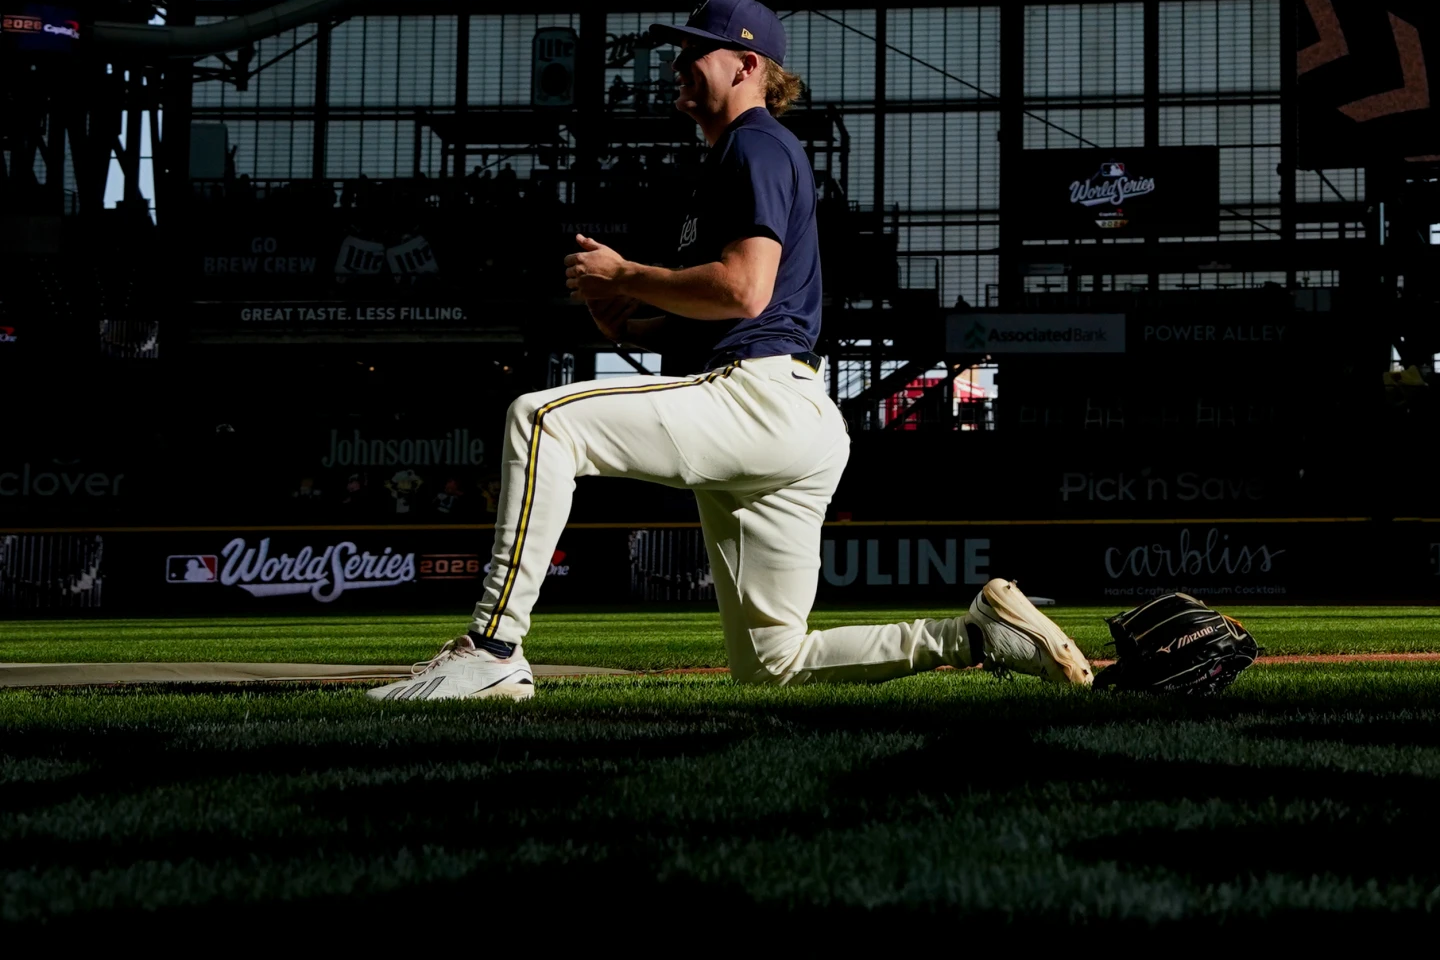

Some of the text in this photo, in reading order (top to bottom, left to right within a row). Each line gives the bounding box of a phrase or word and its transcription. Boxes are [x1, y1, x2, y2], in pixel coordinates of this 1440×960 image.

[560, 222, 629, 234] TASTES LIKE
[250, 236, 278, 254] GO
[203, 255, 317, 275] BREW CREW
[240, 306, 468, 322] GREAT TASTE. LESS FILLING.
[1143, 324, 1288, 342] POWER ALLEY
[321, 427, 486, 469] Johnsonville
[0, 462, 125, 497] clover
[1059, 471, 1137, 502] Pick
[1175, 471, 1267, 501] Save
[1104, 527, 1287, 579] carbliss
[420, 558, 480, 574] 2026
[822, 538, 991, 588] ULINE
[1104, 583, 1287, 597] Hand Crafted Premium Cocktails
